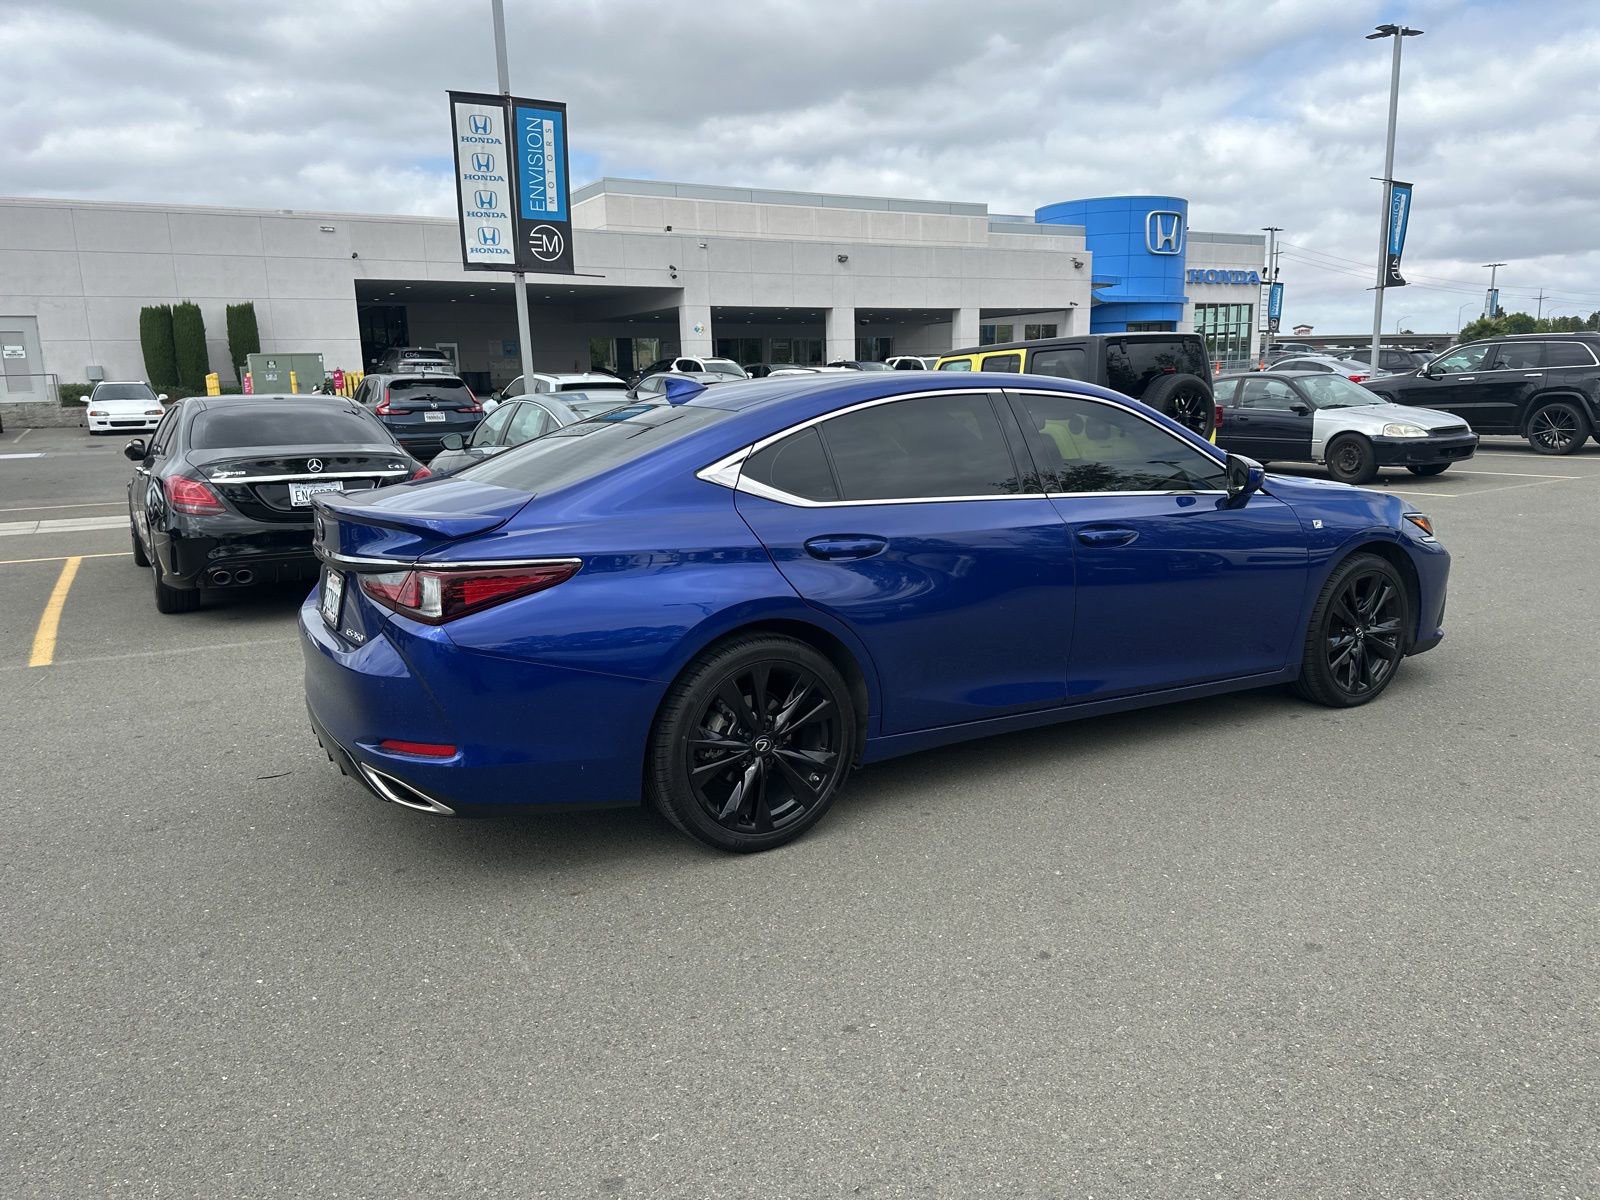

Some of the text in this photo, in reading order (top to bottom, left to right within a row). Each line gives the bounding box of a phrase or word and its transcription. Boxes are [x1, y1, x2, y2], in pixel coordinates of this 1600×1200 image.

[461, 136, 502, 144] HONDA
[526, 117, 545, 211] ENVISION
[545, 128, 555, 205] MOTORS
[464, 173, 504, 181] HONDA
[1186, 269, 1260, 285] HONDA
